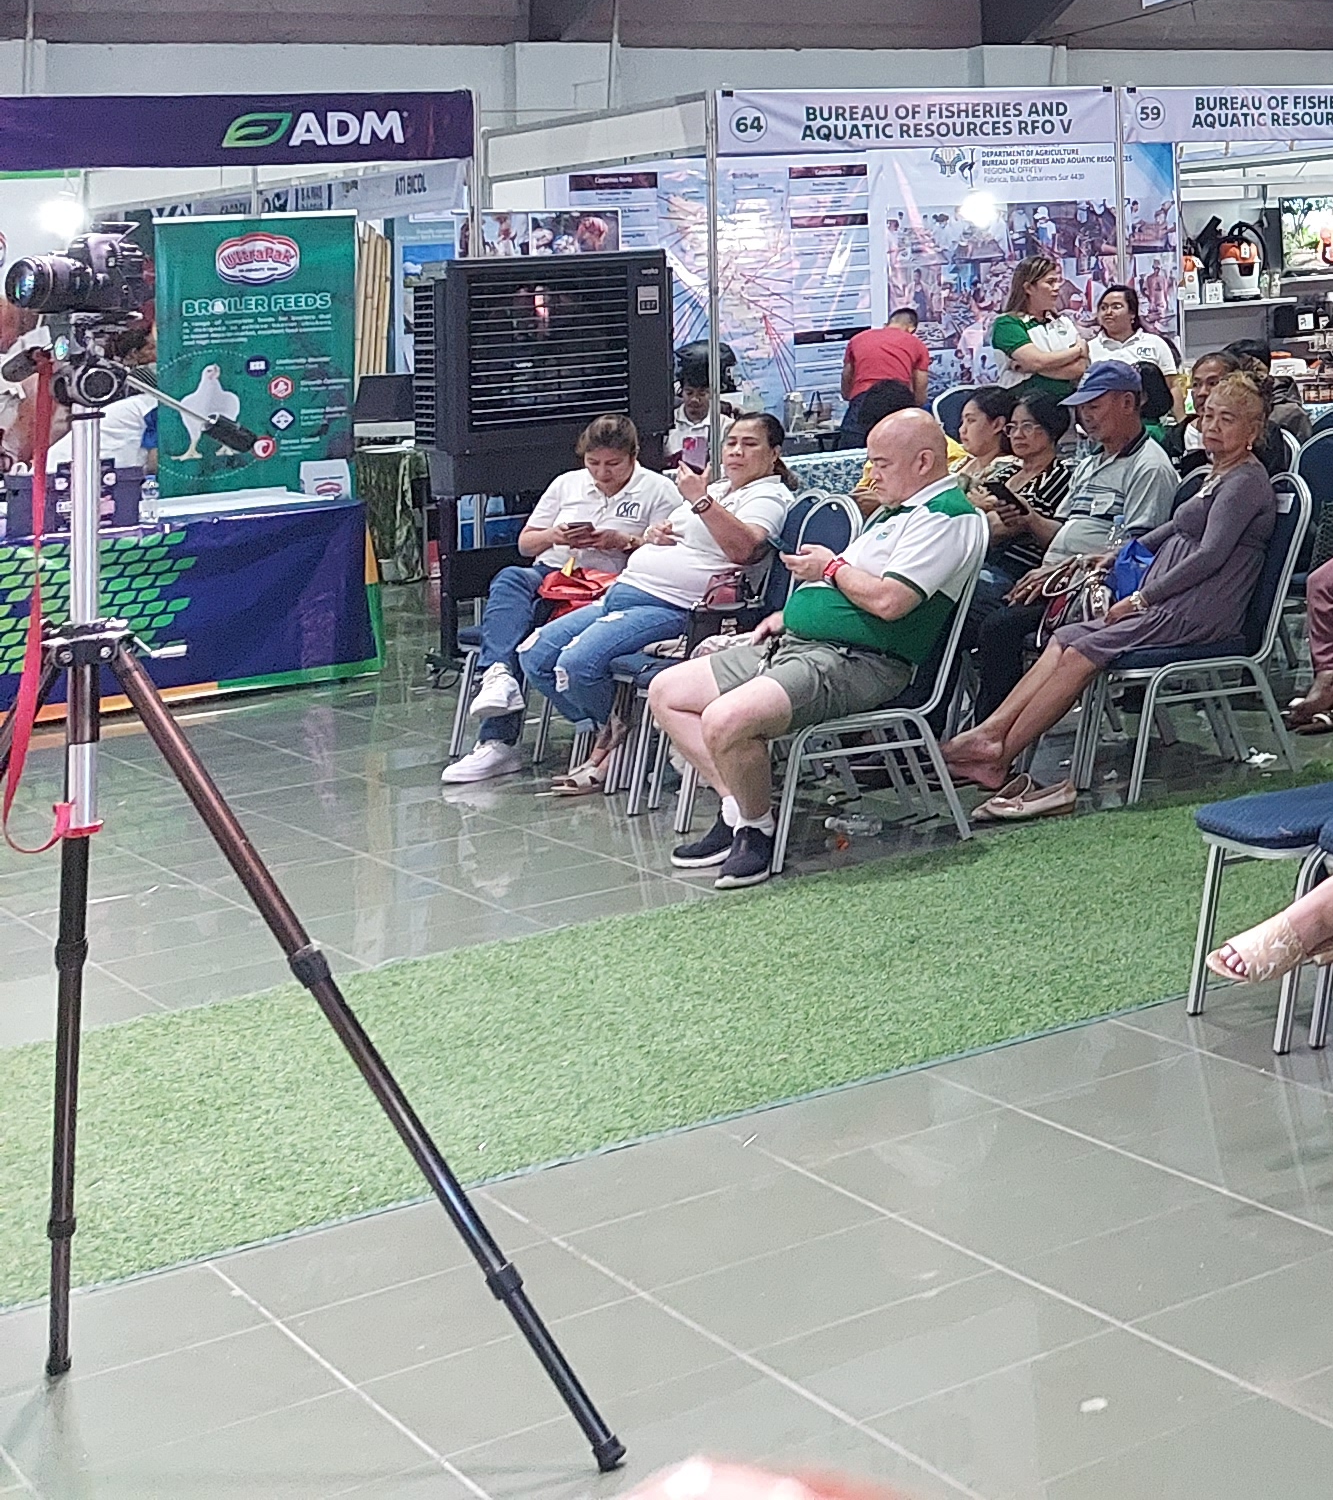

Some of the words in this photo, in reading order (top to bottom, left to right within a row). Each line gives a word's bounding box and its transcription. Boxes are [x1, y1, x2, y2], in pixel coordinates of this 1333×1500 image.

[805, 105, 889, 122] BUREAU
[895, 104, 922, 121] OF
[926, 102, 1023, 120] FISHERIES
[1027, 101, 1068, 118] AND
[1195, 96, 1262, 111] BUREAU
[1267, 95, 1289, 110] OF
[1140, 106, 1161, 121] 59
[1191, 112, 1267, 130] AQUATIC
[288, 110, 404, 146] ADM
[735, 116, 764, 133] 64
[801, 123, 893, 141] AQUATIC
[899, 119, 1013, 139] RESOURCES
[1018, 118, 1056, 136] RFO
[1059, 118, 1073, 134] V
[982, 149, 1026, 158] DEPARTMENT
[1026, 149, 1034, 157] OF
[1035, 148, 1079, 157] AGRICULTURE
[982, 158, 1008, 167] BUREAU
[1009, 158, 1019, 166] OF
[1020, 157, 1050, 166] FISHERIES
[1051, 157, 1066, 165] AND
[1067, 156, 1096, 165] AQUATIC
[984, 166, 1016, 175] REGIONAL
[407, 173, 427, 195] BICOL
[221, 248, 295, 271] UltraPak
[182, 296, 267, 316] BROILER
[271, 293, 332, 312] FEEDS
